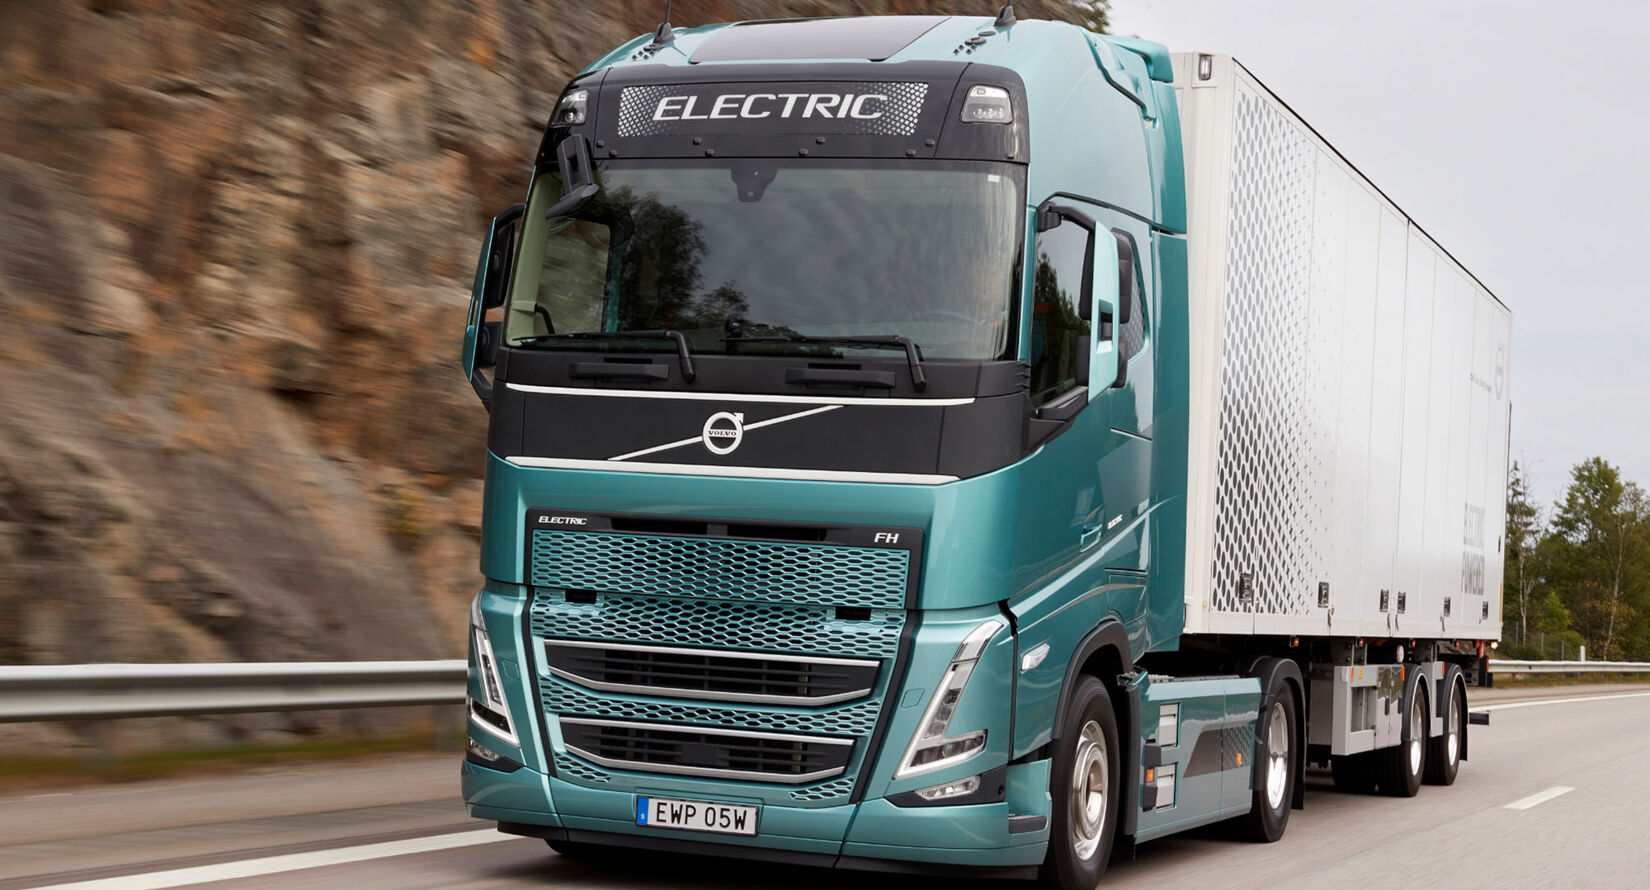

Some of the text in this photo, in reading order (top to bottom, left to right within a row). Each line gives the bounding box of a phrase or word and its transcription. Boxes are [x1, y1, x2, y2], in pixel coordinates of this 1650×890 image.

[652, 93, 889, 122] ELECTRIC
[538, 515, 588, 525] ELECTRIC
[873, 532, 900, 544] FH
[656, 802, 747, 831] EWP 05W
